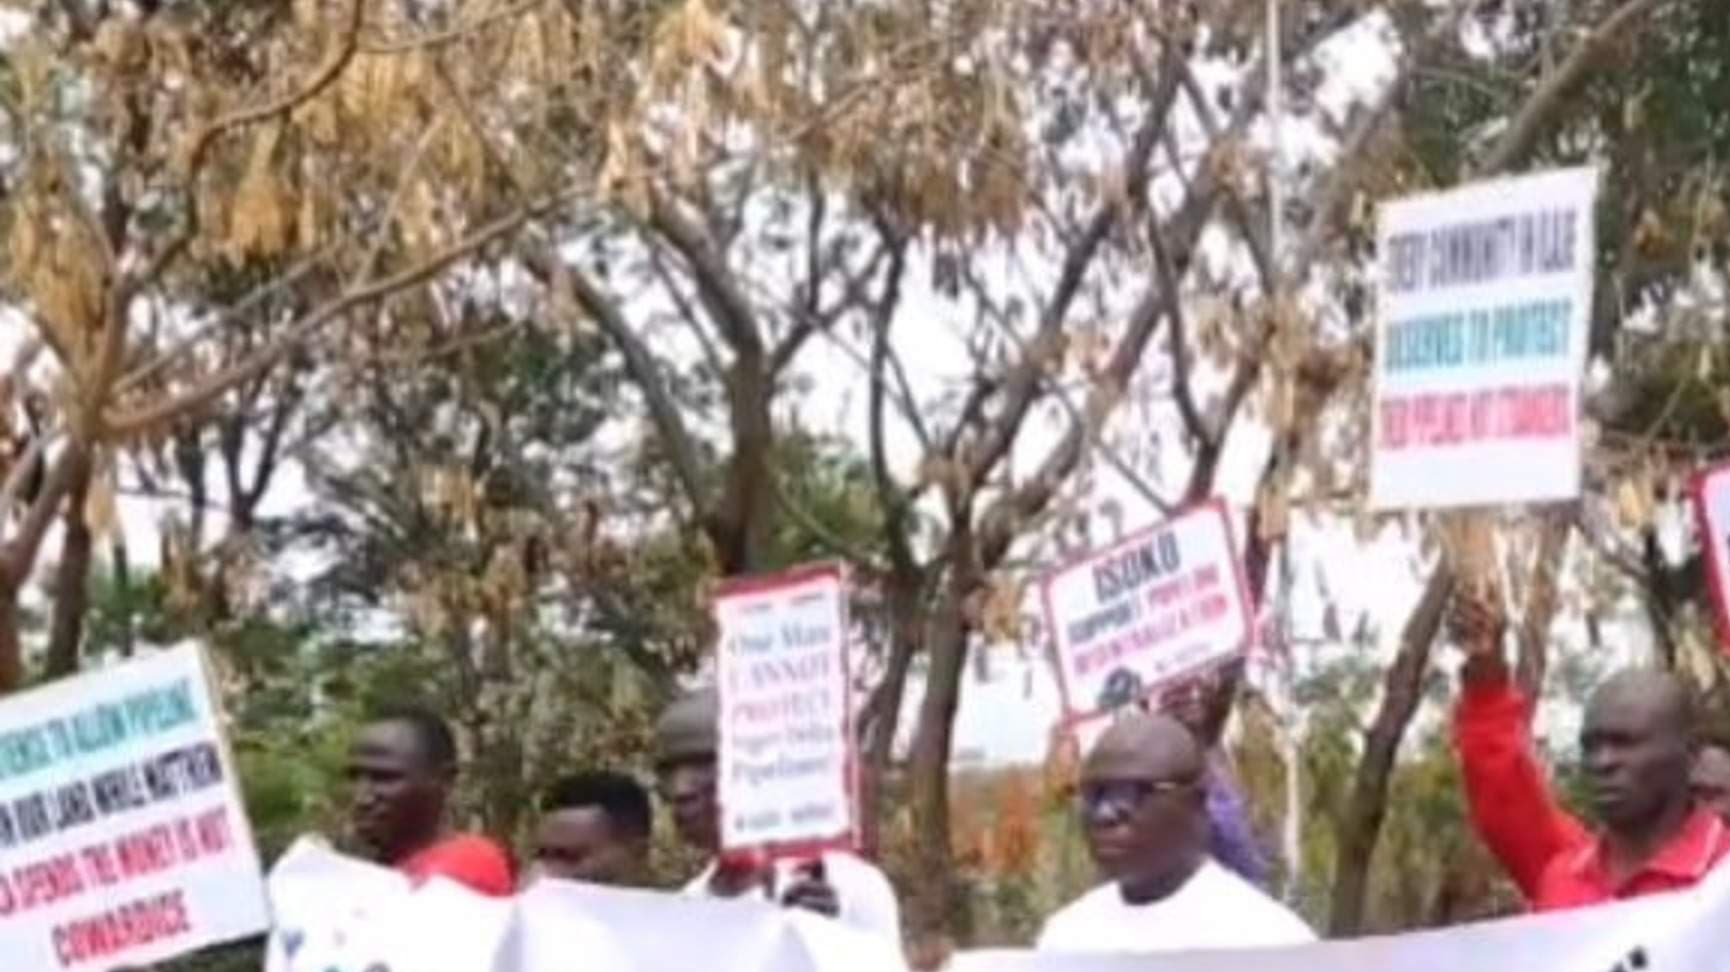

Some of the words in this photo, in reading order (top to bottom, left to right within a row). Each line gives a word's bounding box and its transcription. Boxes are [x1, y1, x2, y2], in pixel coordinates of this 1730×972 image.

[1067, 595, 1142, 643] SUPPORT
[1147, 562, 1220, 608] PIPELINE
[1092, 531, 1181, 604] ISOKO
[125, 678, 201, 737] PIPELINE
[92, 763, 144, 816] WHILE
[143, 740, 225, 800] MATTHEW
[116, 820, 178, 880] MONEY
[51, 889, 193, 968] COWARDICE
